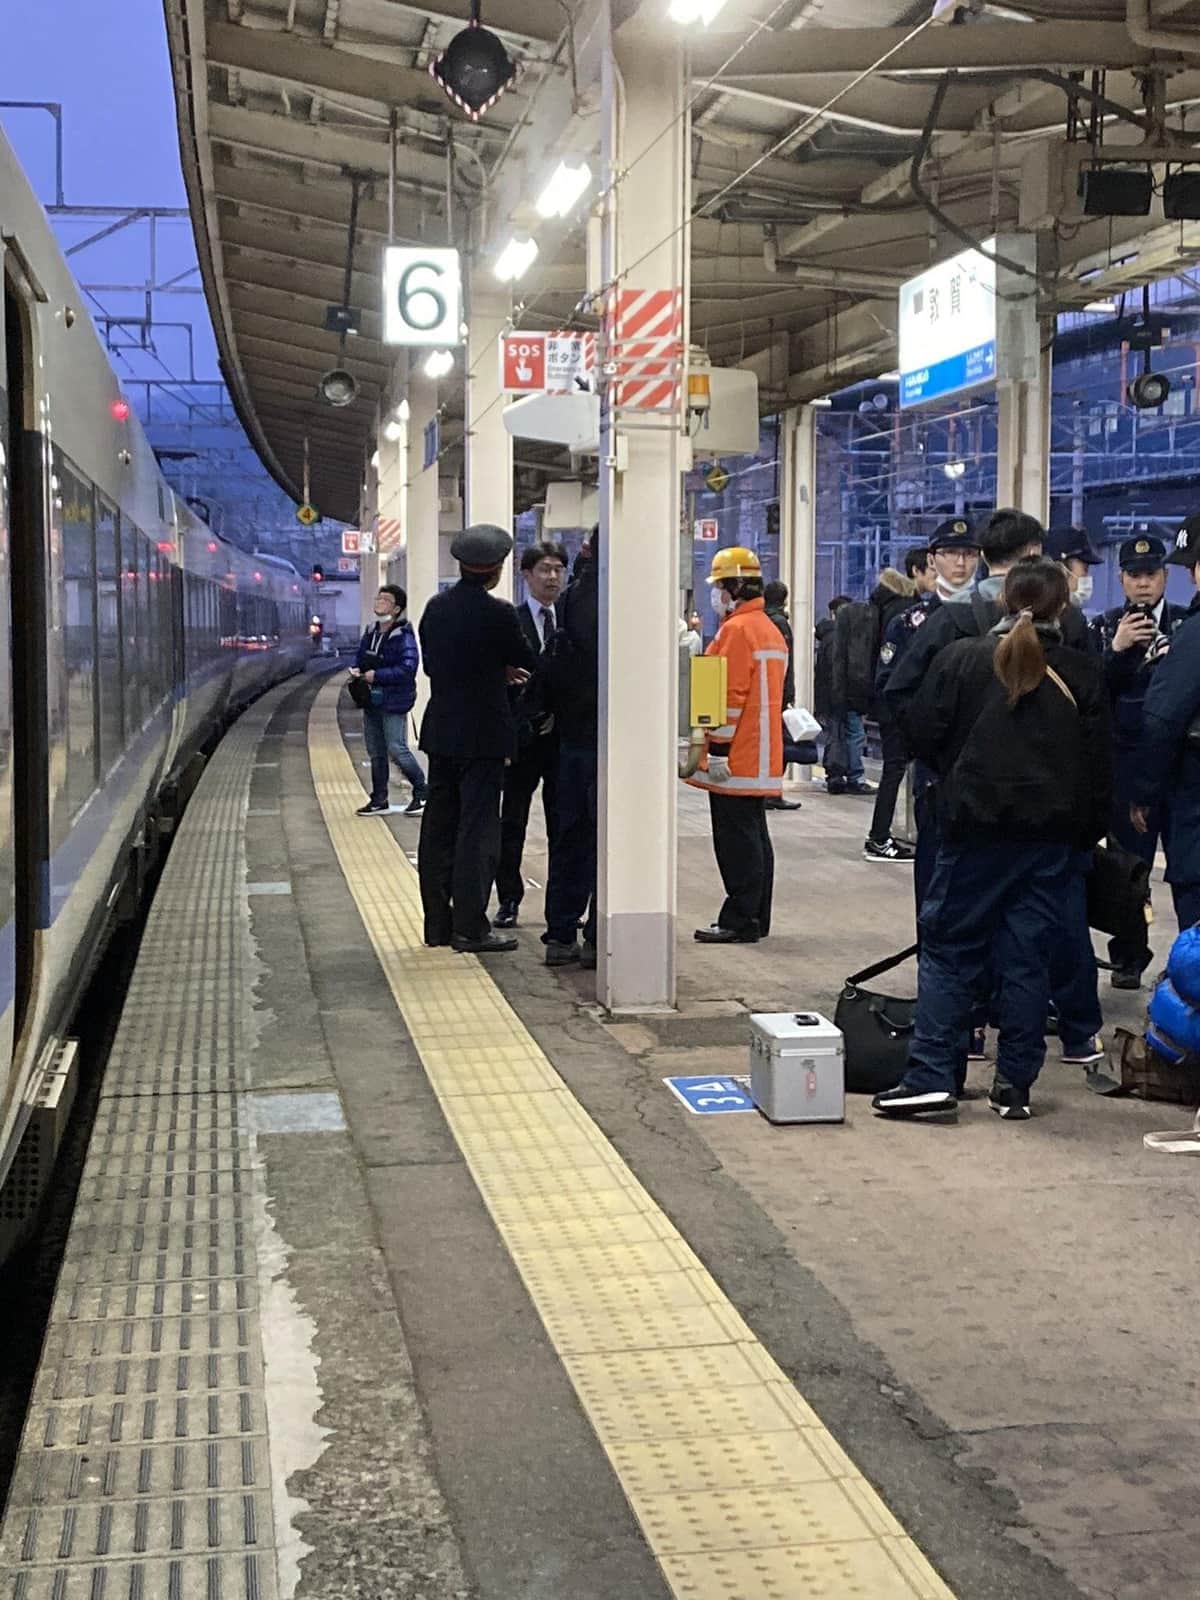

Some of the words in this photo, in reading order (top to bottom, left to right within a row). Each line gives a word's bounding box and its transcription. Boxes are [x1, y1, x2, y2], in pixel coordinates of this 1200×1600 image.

[398, 260, 447, 331] 6
[508, 343, 541, 357] SOS
[547, 352, 581, 364] ボタン
[302, 507, 311, 521] 4
